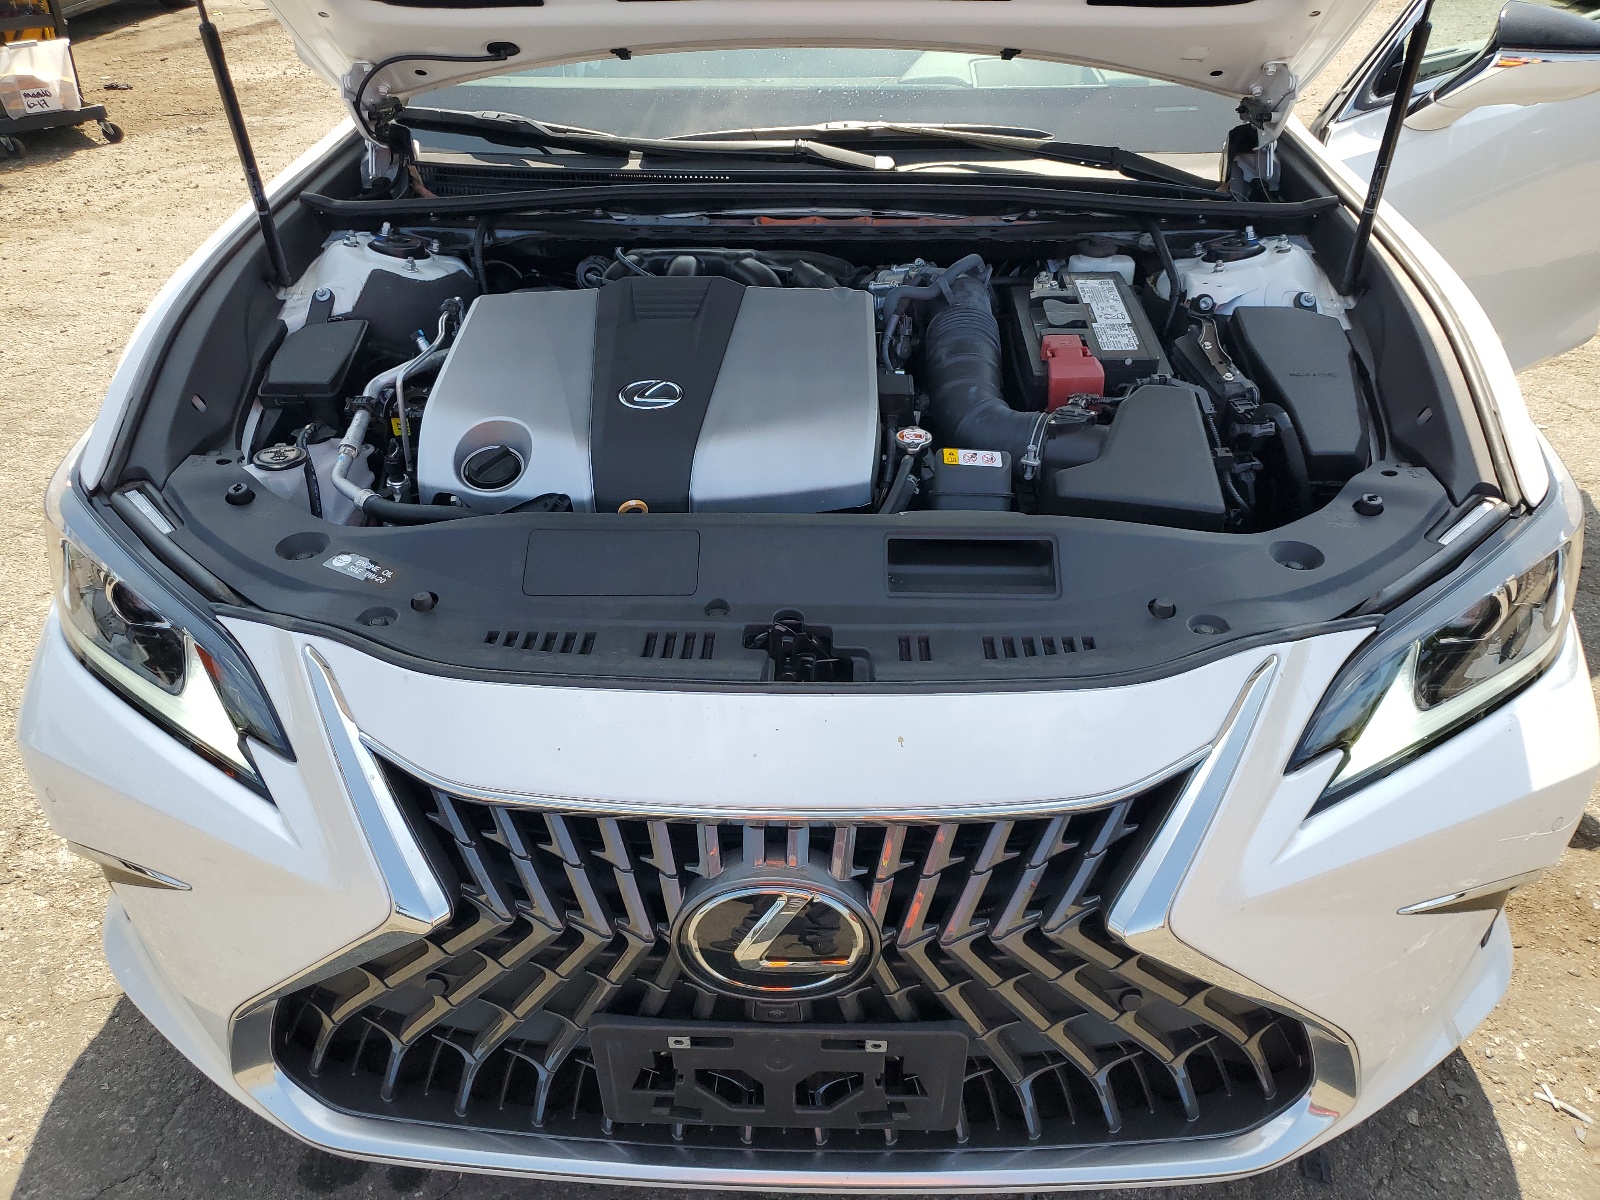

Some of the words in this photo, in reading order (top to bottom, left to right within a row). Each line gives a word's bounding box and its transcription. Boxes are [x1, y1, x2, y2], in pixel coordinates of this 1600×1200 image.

[347, 565, 364, 575] SAE
[354, 559, 382, 573] ENGINE
[381, 569, 394, 578] OIL
